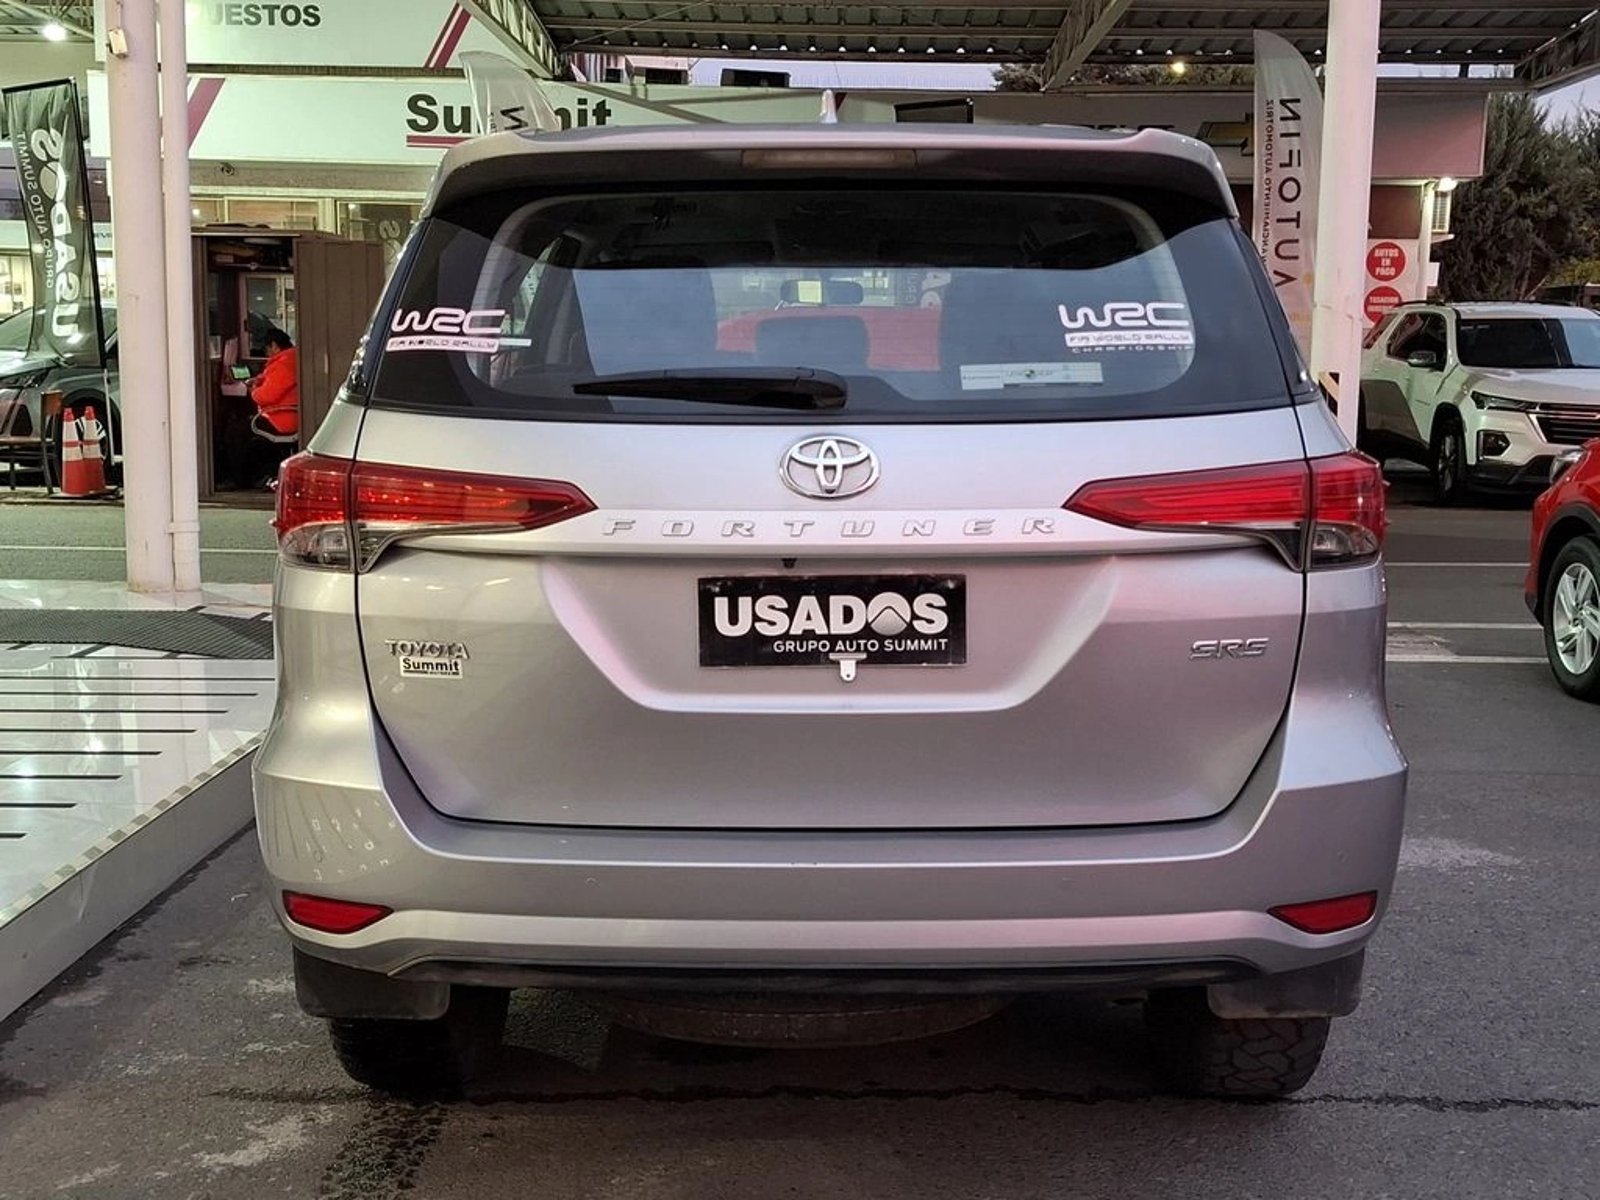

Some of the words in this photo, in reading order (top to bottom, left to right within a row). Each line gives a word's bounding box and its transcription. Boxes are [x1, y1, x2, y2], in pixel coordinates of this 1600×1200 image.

[391, 307, 506, 335] WRC
[1058, 302, 1190, 328] WRC
[603, 518, 1056, 538] FORTUNER
[714, 592, 949, 637] USADOS
[384, 638, 470, 659] TOYOTA
[773, 639, 831, 653] GRUPO
[835, 639, 880, 652] AUTO
[884, 638, 948, 651] SUMMIT
[402, 657, 460, 671] Summit
